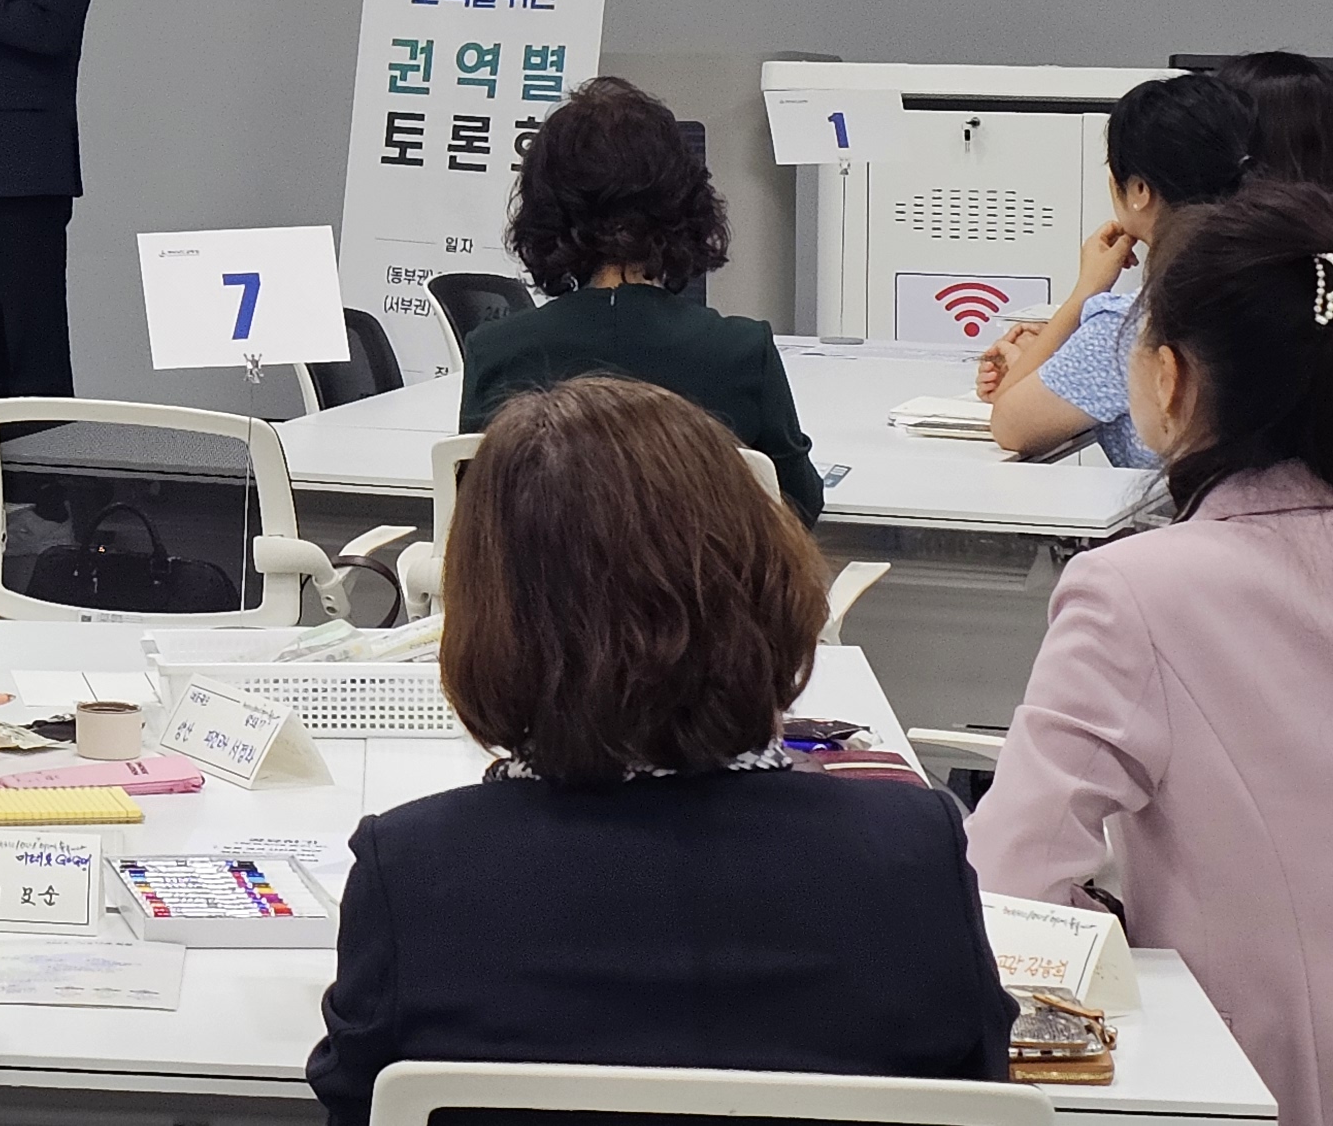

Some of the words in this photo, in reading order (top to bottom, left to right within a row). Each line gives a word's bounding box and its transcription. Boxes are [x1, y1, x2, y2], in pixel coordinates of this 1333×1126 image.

[827, 112, 850, 149] 1
[445, 236, 474, 254] 일자
[221, 272, 261, 341] 7
[383, 295, 431, 317] (서부권)
